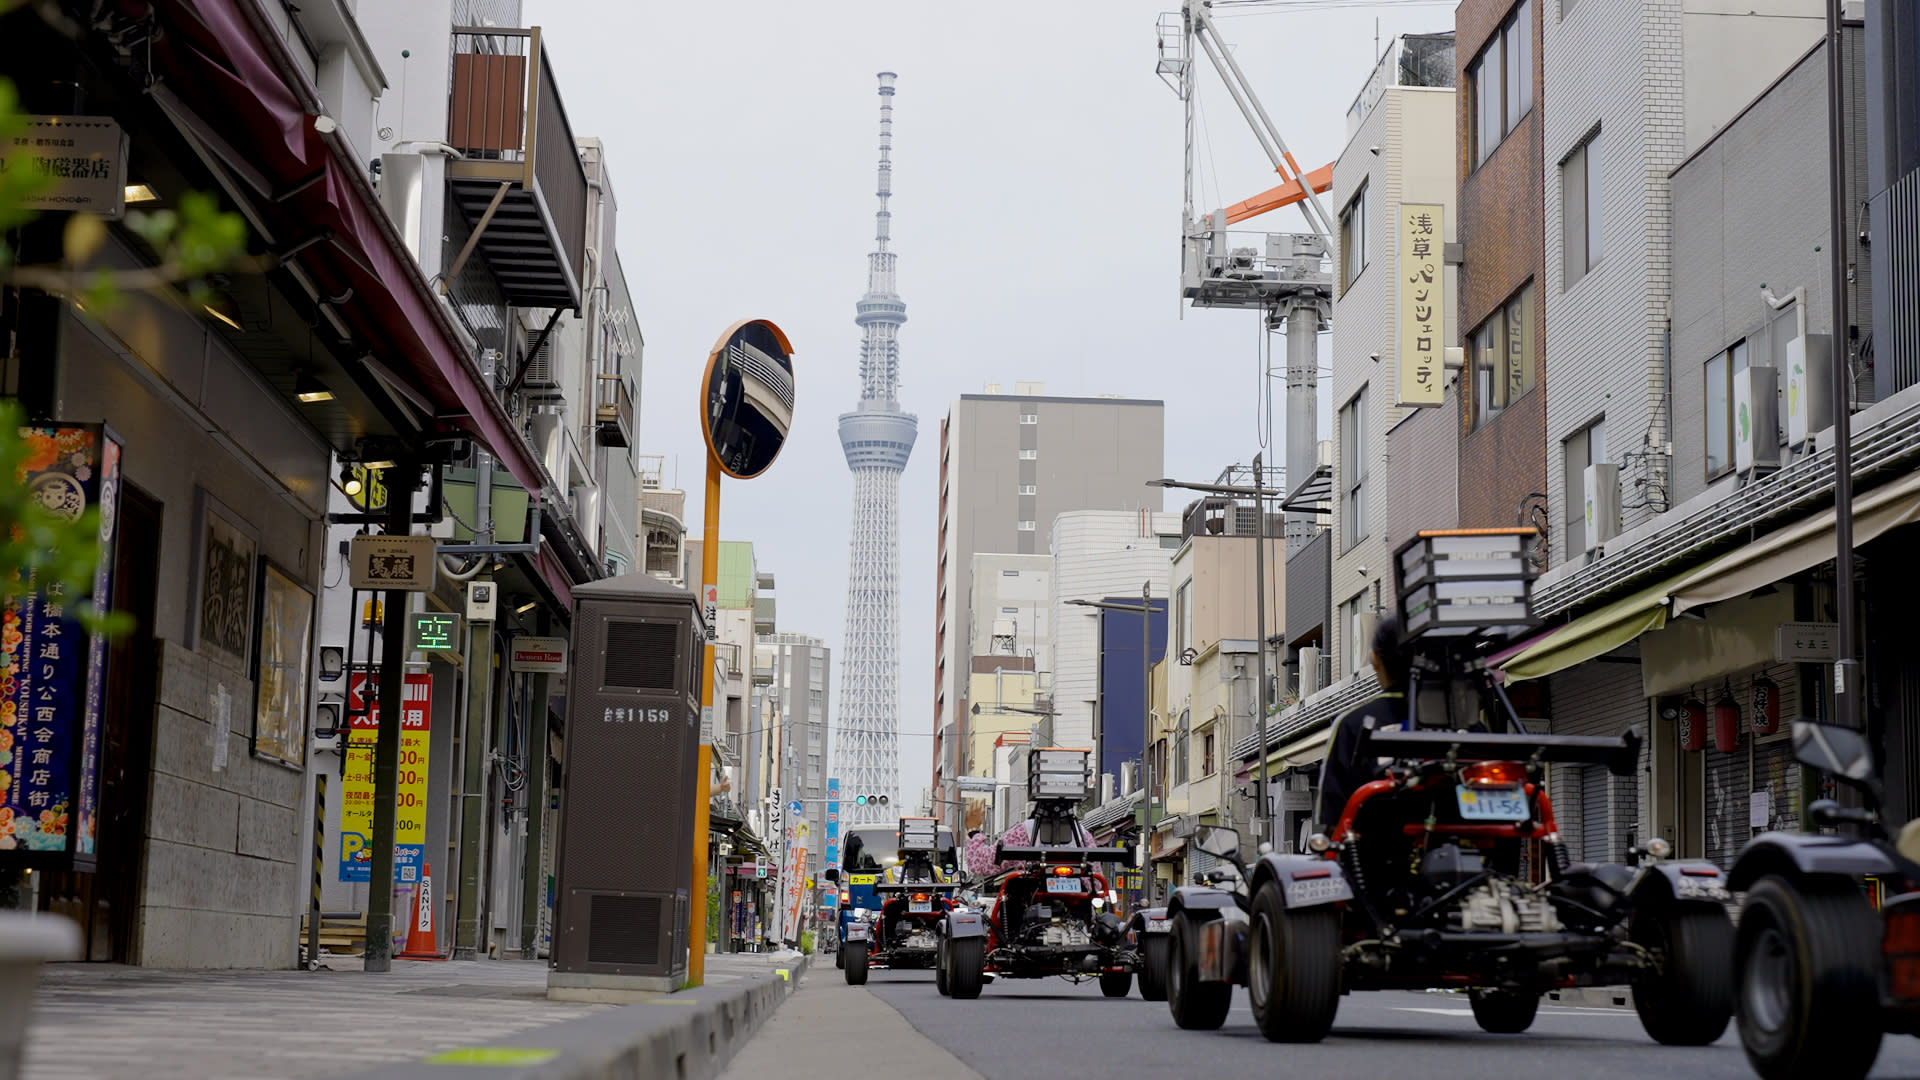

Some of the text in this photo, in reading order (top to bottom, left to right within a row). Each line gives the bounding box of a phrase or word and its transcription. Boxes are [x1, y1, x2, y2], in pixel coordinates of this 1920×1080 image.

[1409, 213, 1435, 393] 浅草パンツェロッティ
[416, 616, 453, 649] 空
[1794, 639, 1830, 650] 七五三
